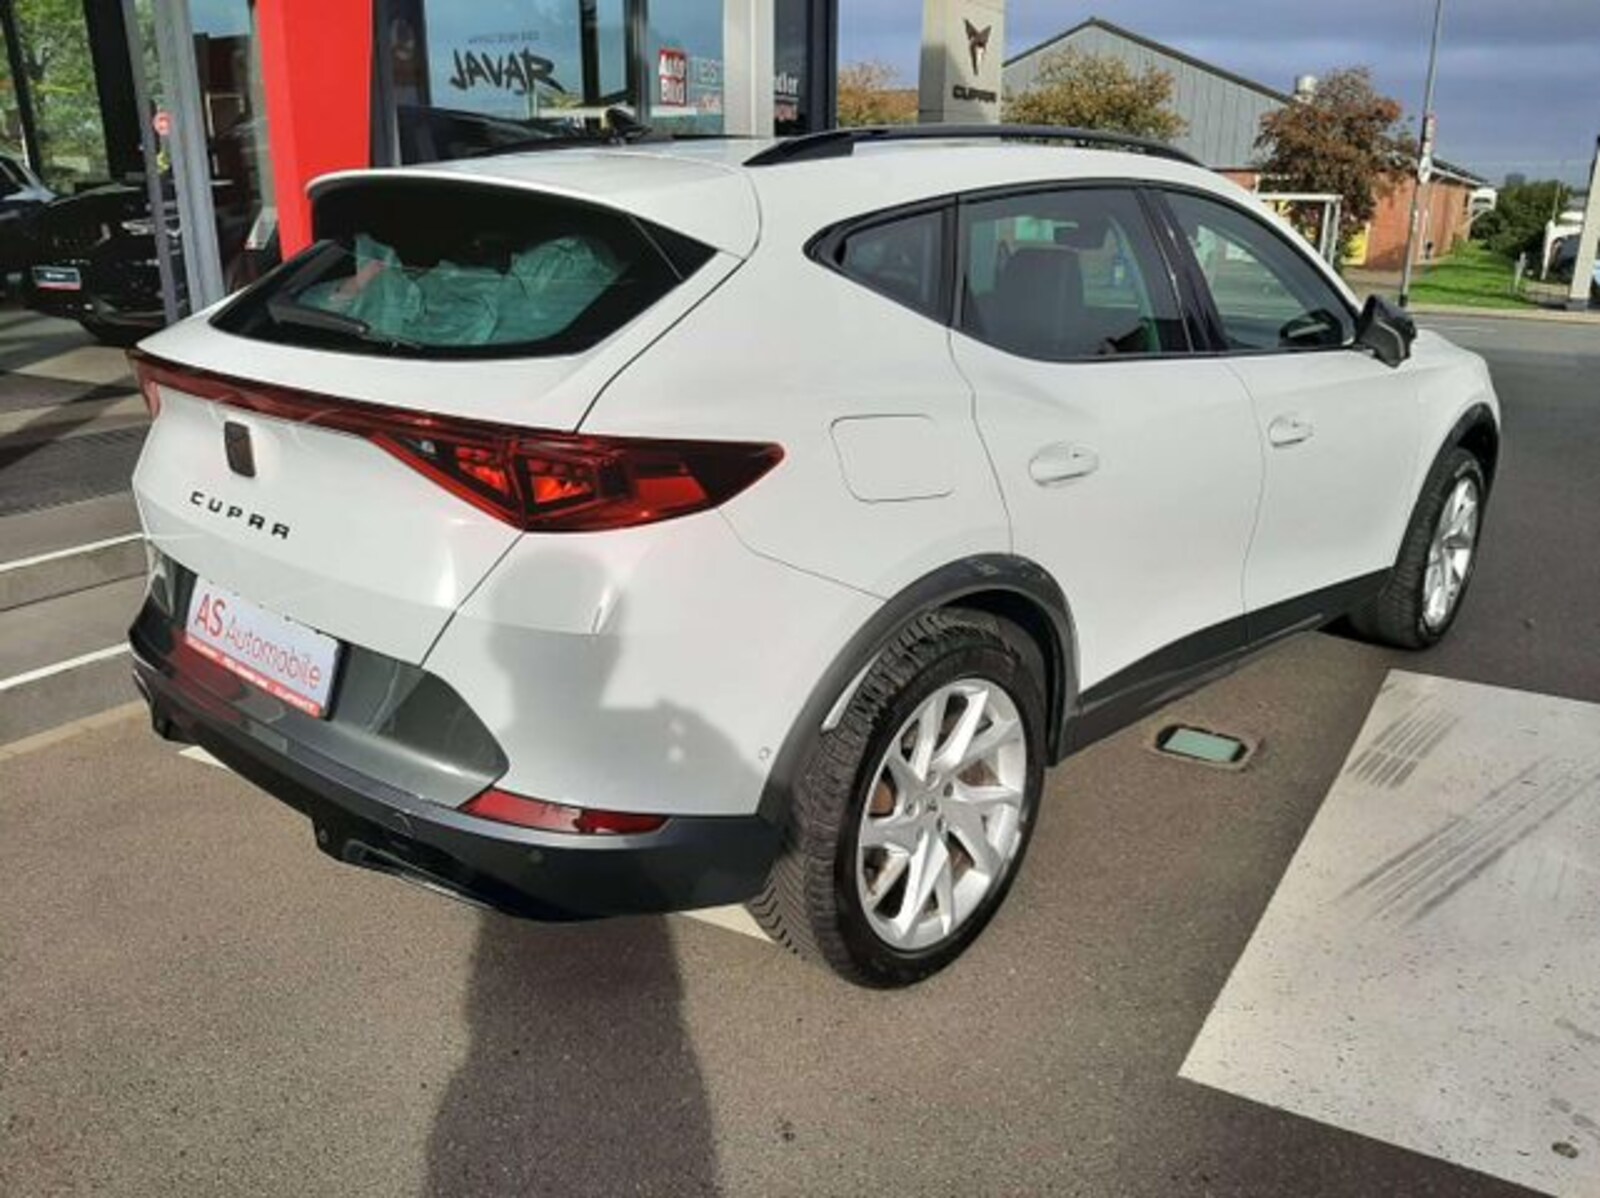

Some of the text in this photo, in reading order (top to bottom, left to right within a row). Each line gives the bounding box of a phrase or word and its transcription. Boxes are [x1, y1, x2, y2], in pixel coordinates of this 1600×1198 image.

[189, 490, 291, 540] CUPRA
[194, 593, 226, 638] AS
[226, 615, 322, 690] Automobile
